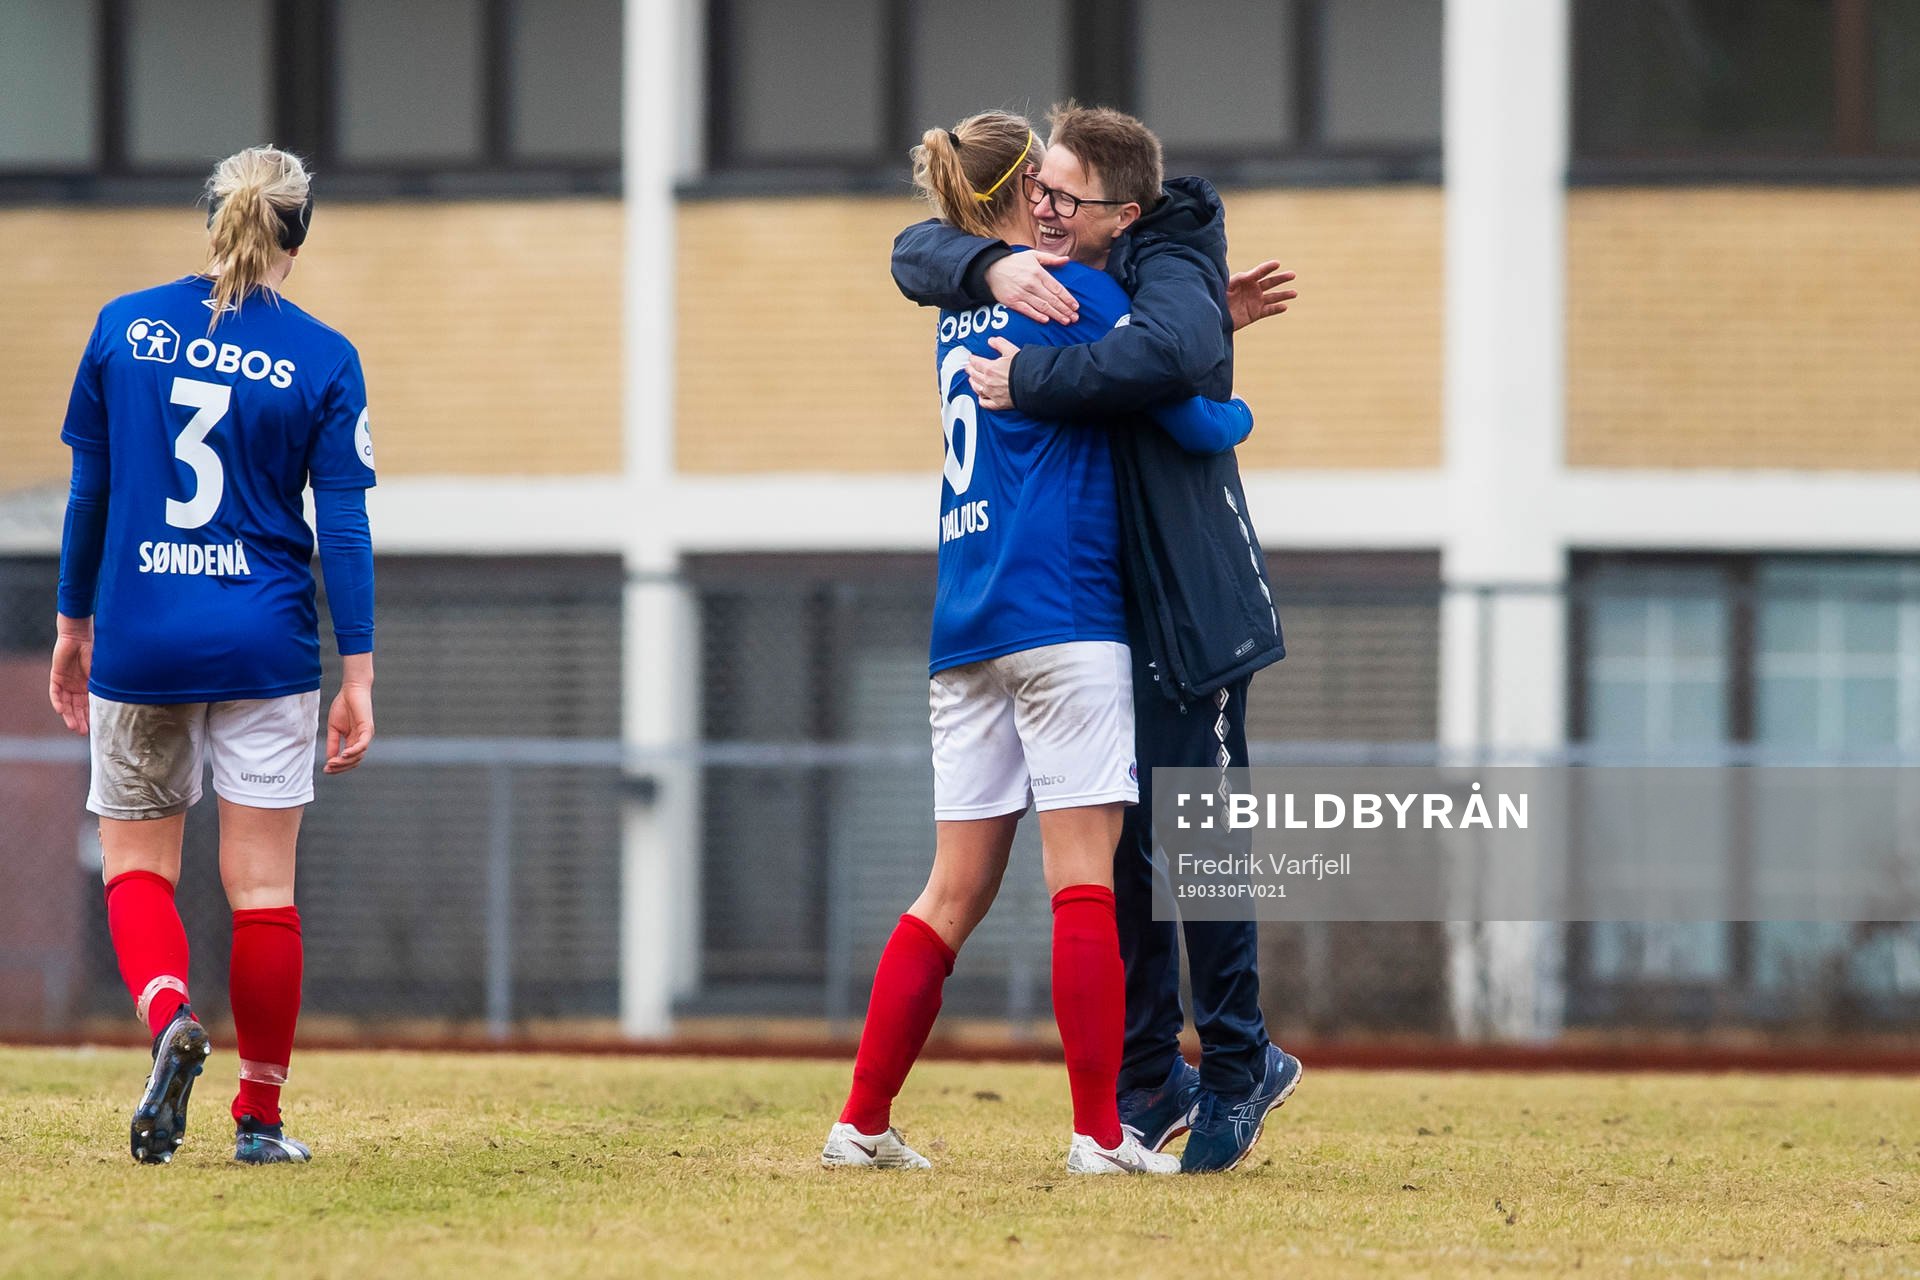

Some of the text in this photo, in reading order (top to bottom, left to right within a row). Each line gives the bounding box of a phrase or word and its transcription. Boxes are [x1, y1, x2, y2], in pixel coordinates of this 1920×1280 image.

[941, 303, 1009, 342] OBOS
[185, 338, 296, 389] OBOS
[941, 345, 977, 496] 6
[165, 376, 232, 530] 3
[139, 538, 251, 576] SØNDENÅ
[240, 772, 286, 784] umbro
[1032, 774, 1066, 787] mbro
